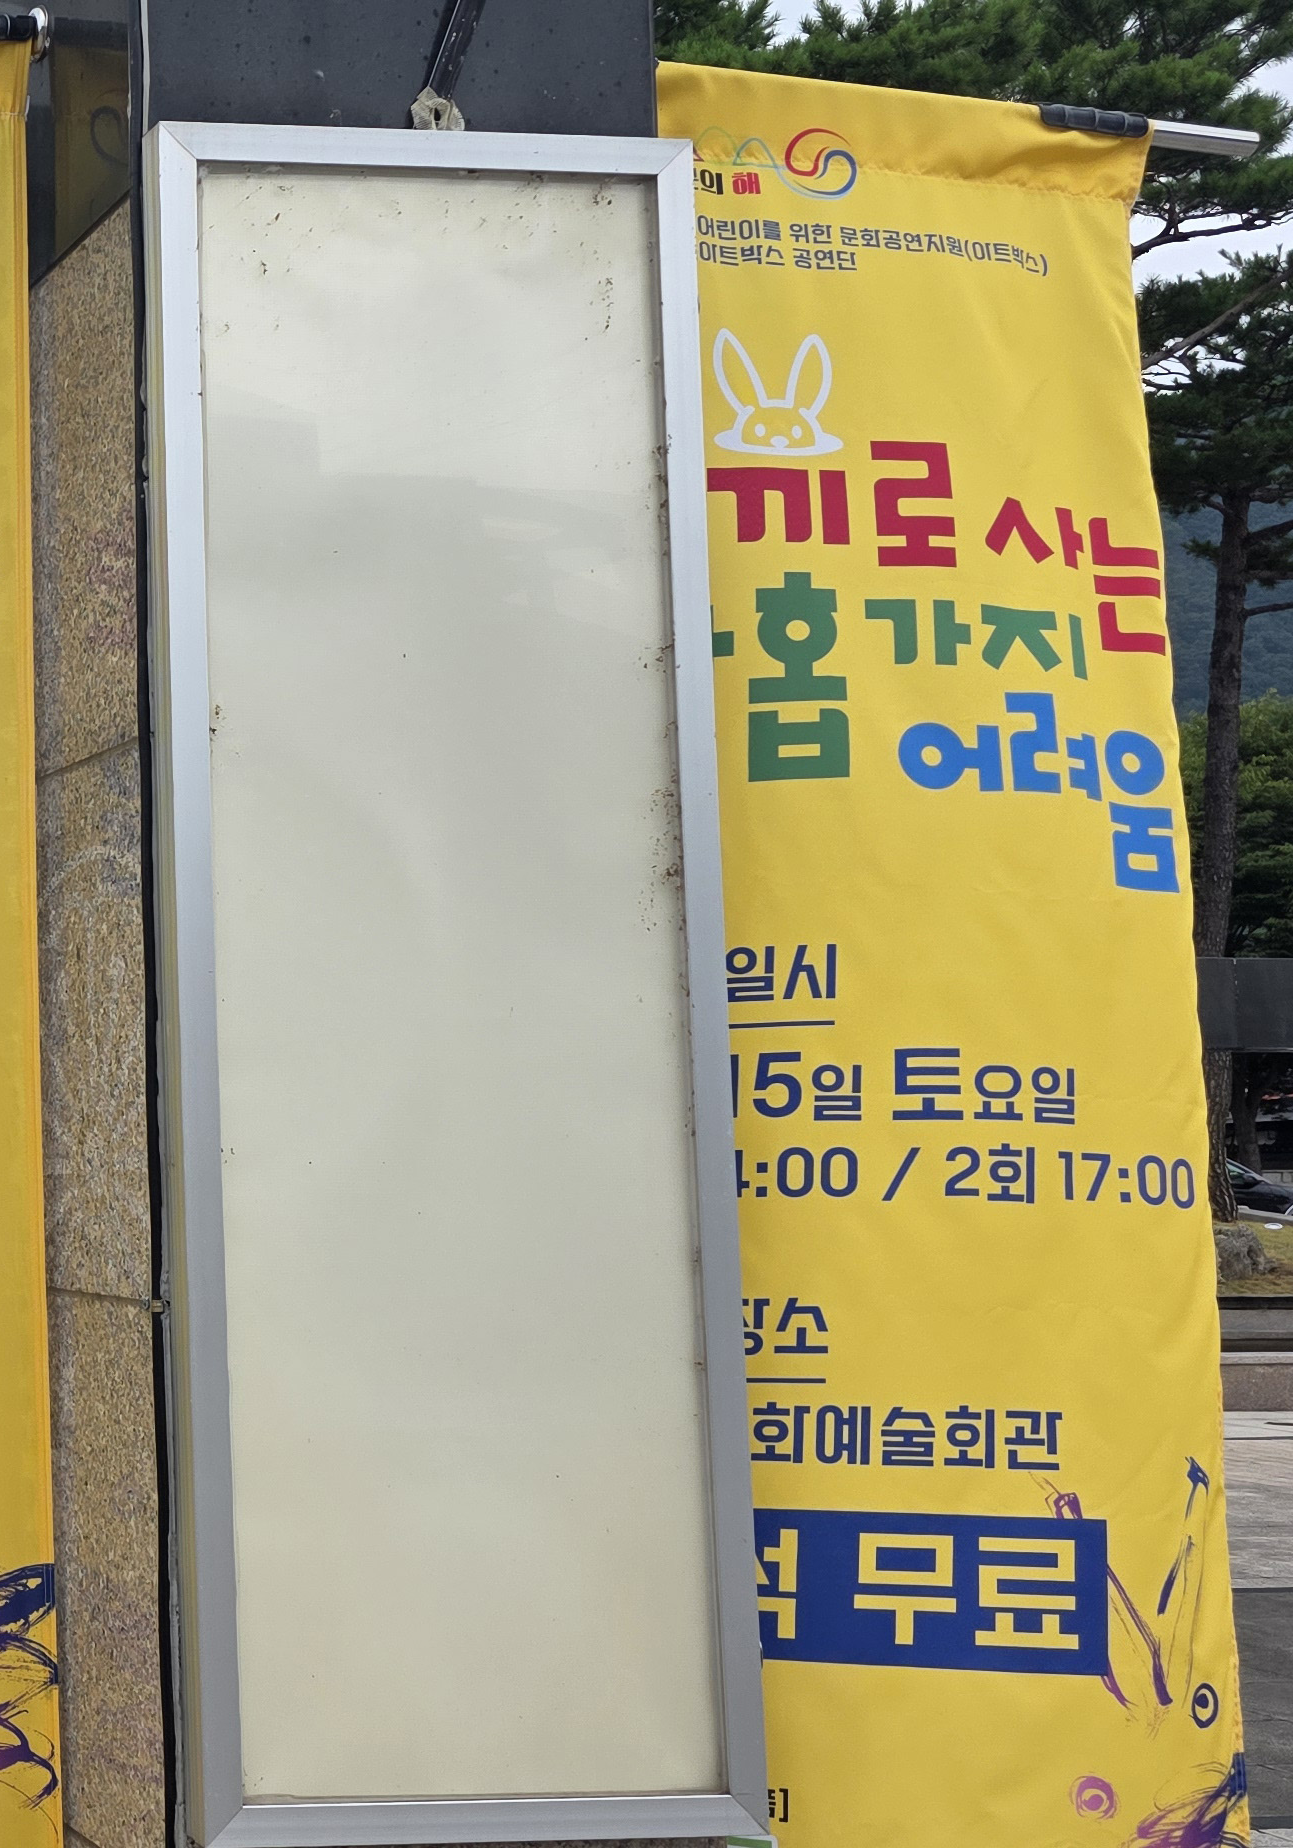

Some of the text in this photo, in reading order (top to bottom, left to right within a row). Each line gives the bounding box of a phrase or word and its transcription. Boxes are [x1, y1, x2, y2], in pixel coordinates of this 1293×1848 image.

[731, 172, 761, 195] 해
[697, 214, 1048, 277] 어린이를 위한 문화공연지원(아트박스)
[793, 247, 857, 271] 공연단
[706, 440, 1167, 657] 끼로 사는
[864, 598, 1089, 681] 가지
[898, 692, 1181, 894] 어려움
[725, 943, 837, 1002] 일시
[892, 1047, 1077, 1126] 토요일
[881, 1146, 921, 1201] /
[944, 1143, 1036, 1204] 2회
[1058, 1150, 1196, 1209] 17:00
[751, 1401, 1063, 1471] 화예술회관
[854, 1531, 1080, 1650] 무료
